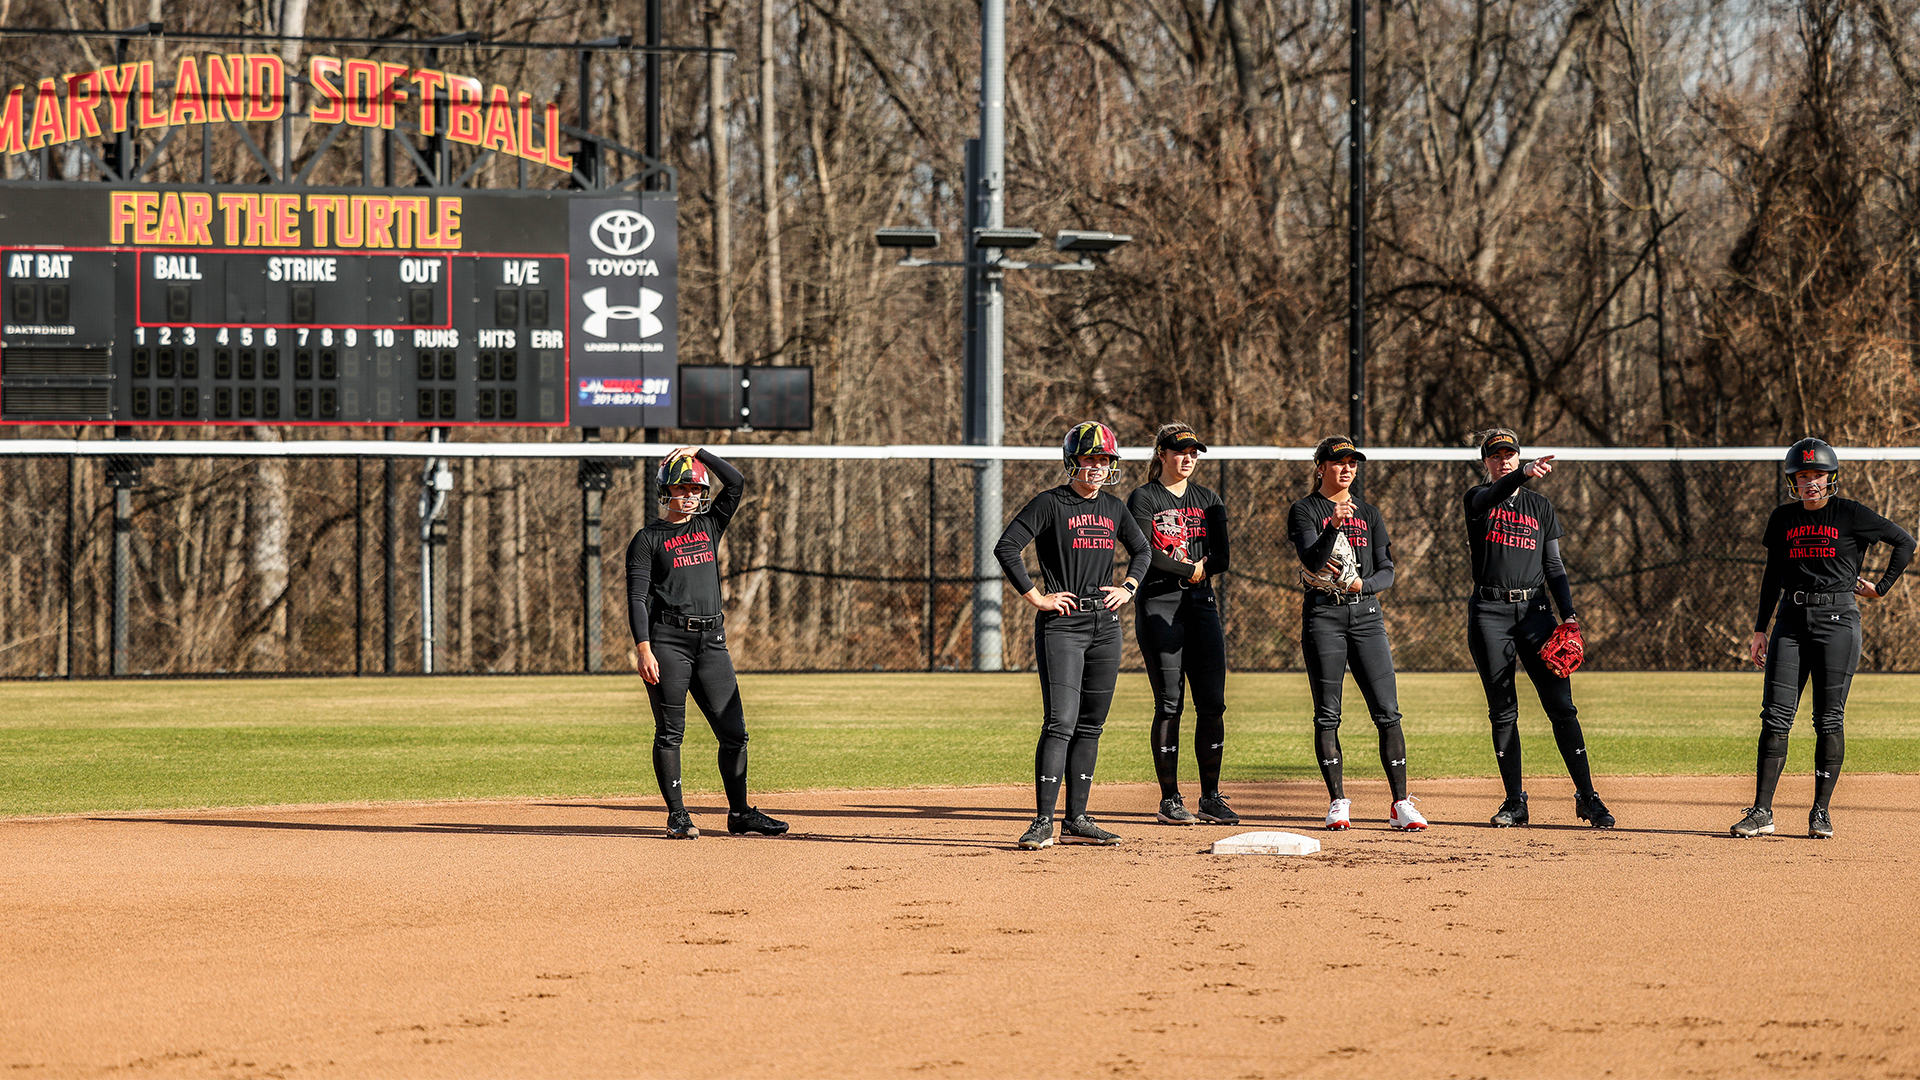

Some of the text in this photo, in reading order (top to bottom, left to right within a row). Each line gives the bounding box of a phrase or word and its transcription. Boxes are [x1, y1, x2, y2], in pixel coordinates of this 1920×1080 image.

[310, 55, 573, 173] SOFTBALL
[110, 191, 462, 249] FEAR THE TURTLE
[8, 254, 73, 279] AT BAT
[153, 255, 202, 280] BALL
[267, 257, 337, 282] STRIKE
[400, 258, 441, 283] OUT
[503, 260, 540, 286] H/E
[586, 259, 659, 276] TOYOTA
[4, 325, 76, 335] DAKTRONICS
[134, 327, 564, 349] 1 2 3 4 5 6 7 8 9 10 RUNS HITS ERR
[584, 342, 620, 352] UNDER
[1803, 450, 1815, 461] M
[1068, 514, 1115, 532] MARYLAND
[1488, 508, 1539, 531] MARYLAND
[1485, 530, 1537, 550] ATHLETICS
[1786, 525, 1839, 541] MARYLAND
[1072, 538, 1115, 550] ATHLETICS
[1789, 547, 1836, 558] ATHLETICS
[673, 551, 714, 568] ATHLETICS
